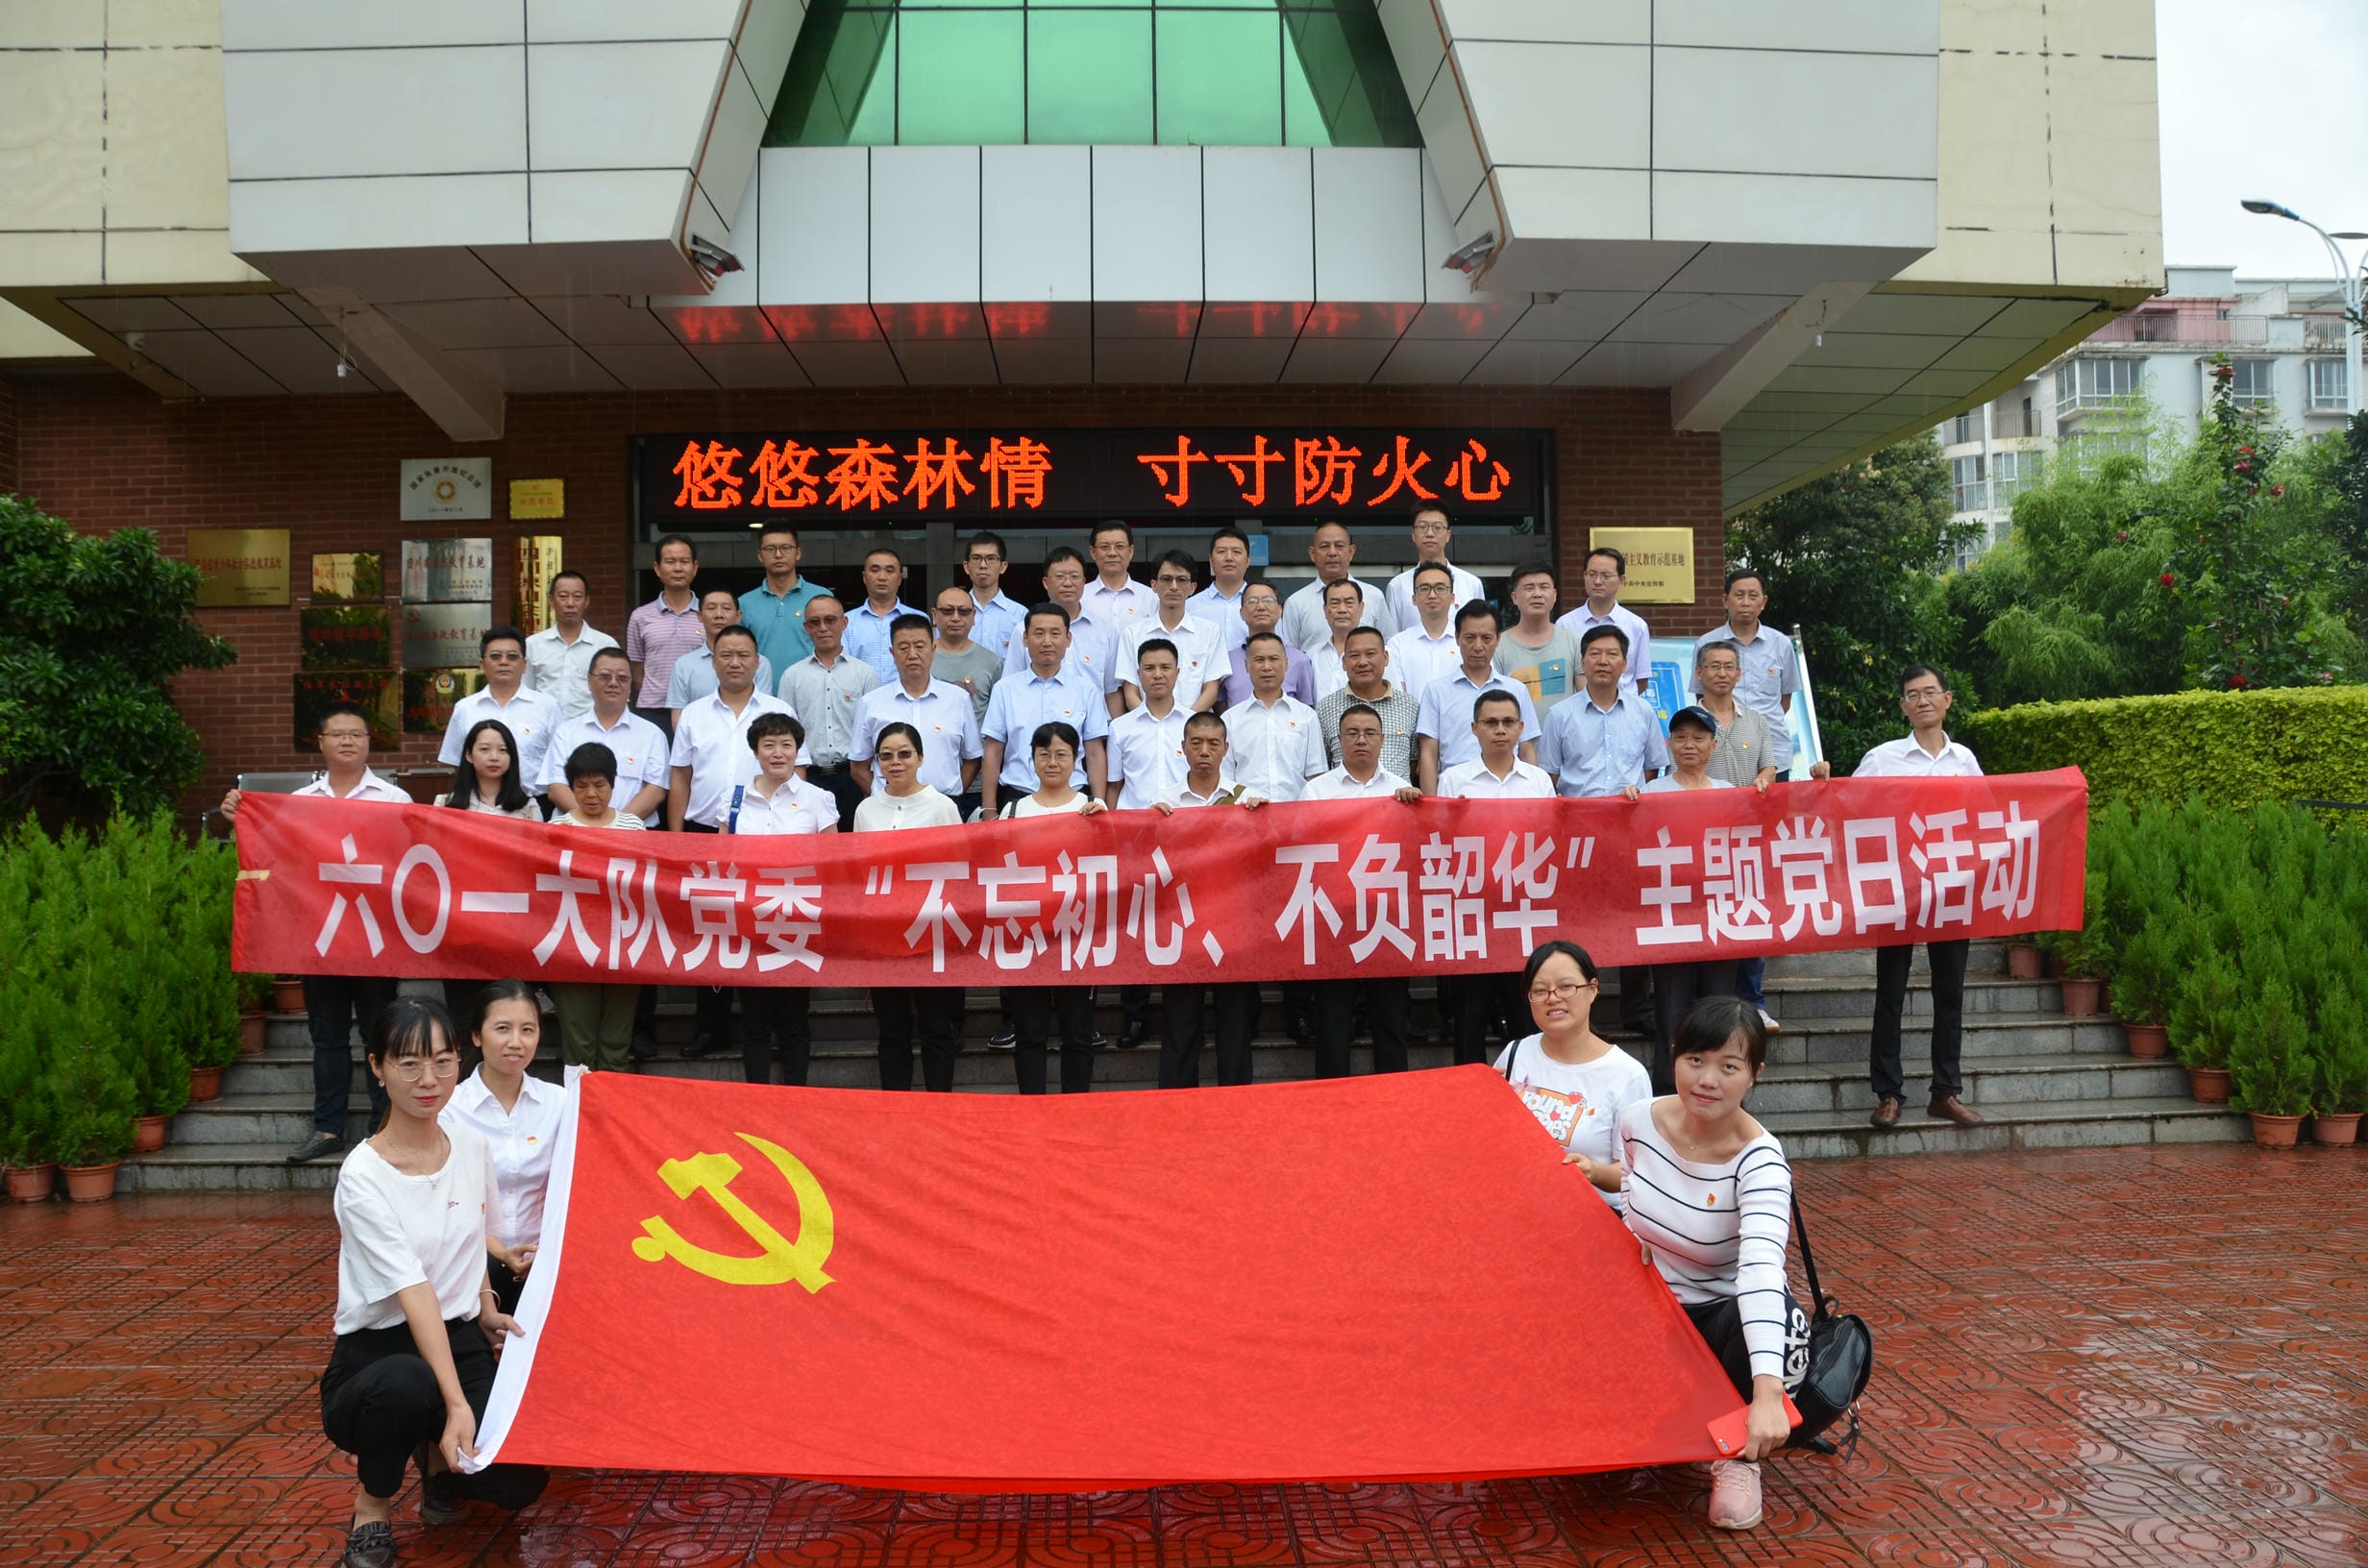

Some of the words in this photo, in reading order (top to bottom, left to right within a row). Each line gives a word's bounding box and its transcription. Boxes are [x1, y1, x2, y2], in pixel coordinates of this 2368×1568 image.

[673, 436, 1053, 511] 悠悠森林情
[1137, 435, 1511, 507] 寸寸防火心
